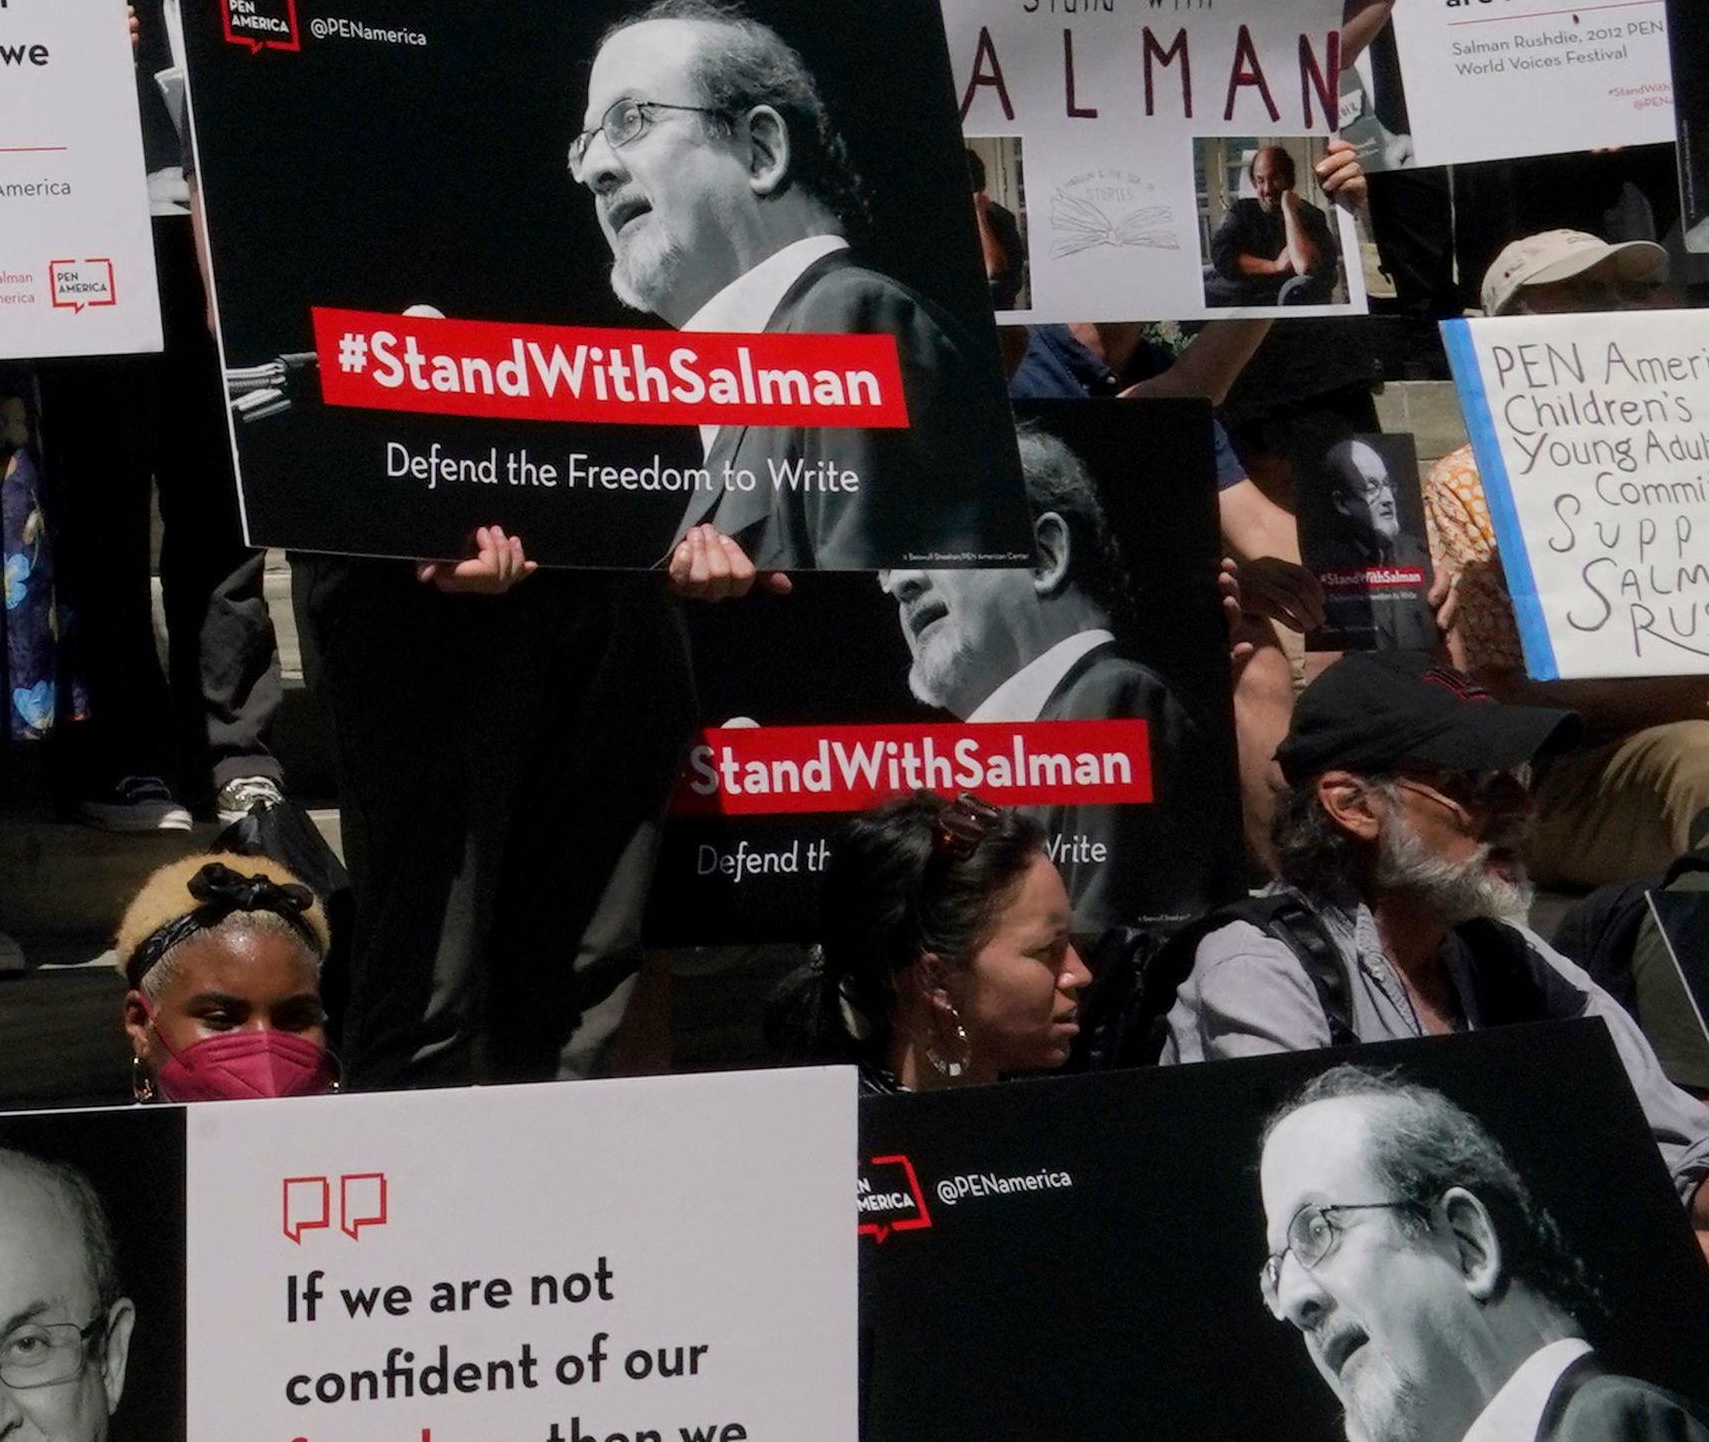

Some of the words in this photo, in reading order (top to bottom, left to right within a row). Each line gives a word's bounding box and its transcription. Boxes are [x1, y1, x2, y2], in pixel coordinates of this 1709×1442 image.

[231, 15, 290, 33] AMERICA
[310, 18, 427, 46] @PENamerica
[1452, 38, 1509, 56] Salman
[1514, 31, 1583, 49] Rushdie,
[1586, 28, 1623, 42] 2012
[1627, 21, 1665, 36] PEN
[960, 24, 1341, 132] ALMAN
[1455, 59, 1505, 76] World
[1509, 53, 1562, 71] Voices
[1566, 45, 1628, 64] Festival
[57, 271, 79, 283] PEN
[58, 281, 108, 295] AMERICA
[338, 331, 882, 408] #StandWithSalman
[1492, 343, 1585, 389] PEN
[1504, 390, 1692, 435] Children's
[386, 441, 498, 489] Defend
[506, 448, 558, 489] the
[567, 453, 712, 493] Freedom
[722, 461, 757, 493] to
[767, 459, 860, 494] Write
[1512, 433, 1638, 475] Young
[1646, 430, 1709, 463] Adul
[1595, 471, 1709, 506] Commi
[689, 735, 1132, 795] StandWithSalman
[698, 839, 798, 883] Defend
[858, 1192, 915, 1211] MERICA
[937, 1168, 1072, 1205] @PENamerica
[287, 1269, 325, 1323] If
[340, 1284, 413, 1319] we
[429, 1276, 513, 1314] are
[530, 1256, 615, 1307] not
[285, 1343, 539, 1406] confident
[555, 1331, 609, 1386] of
[623, 1343, 709, 1381] our
